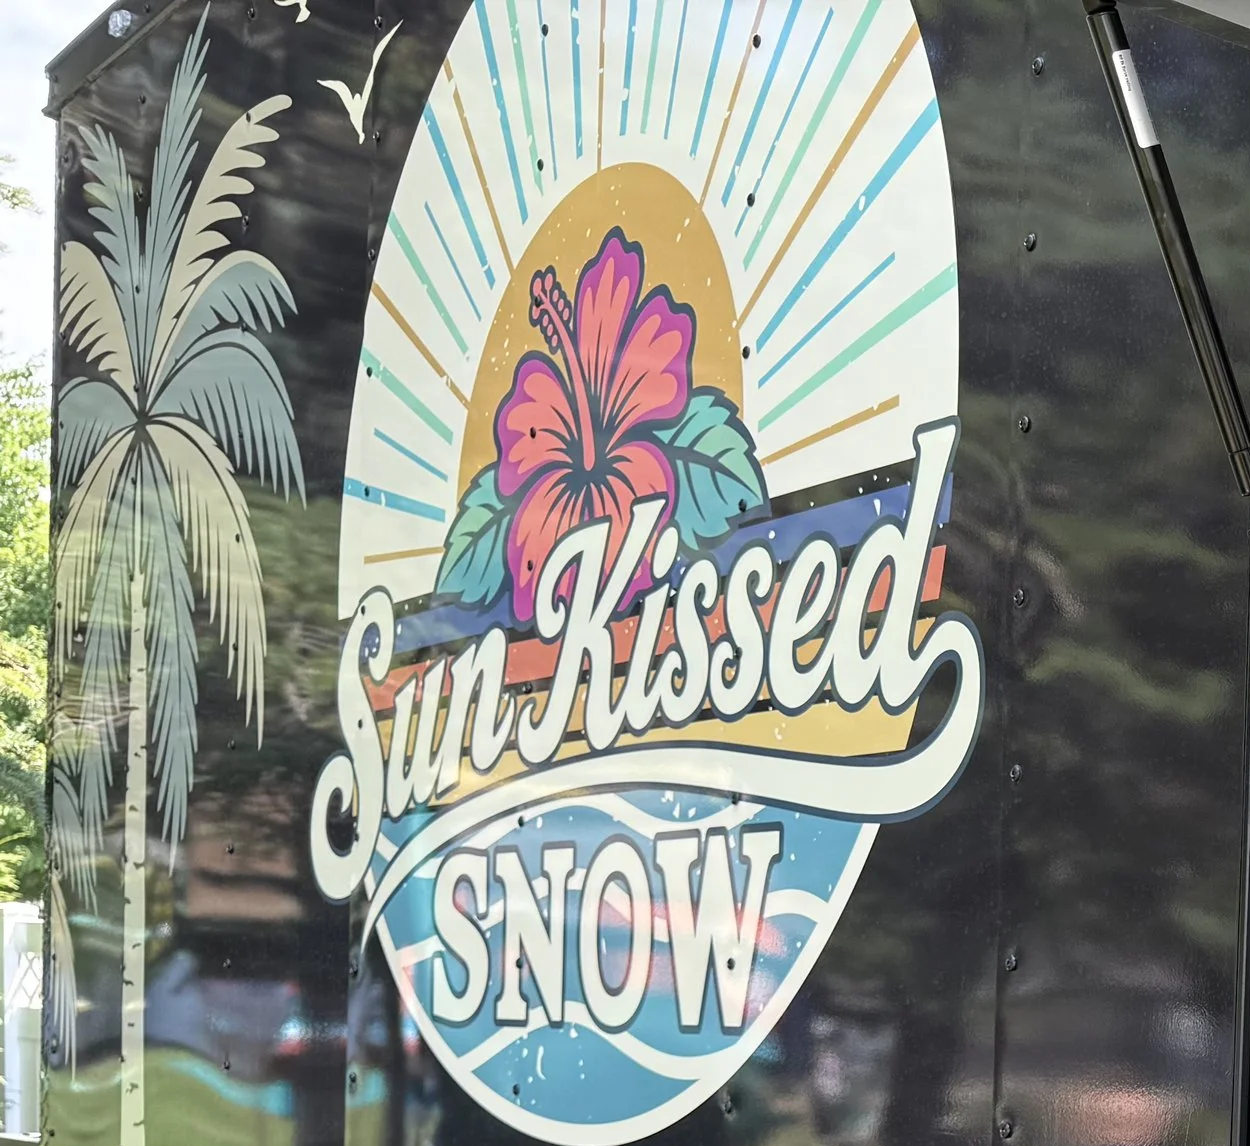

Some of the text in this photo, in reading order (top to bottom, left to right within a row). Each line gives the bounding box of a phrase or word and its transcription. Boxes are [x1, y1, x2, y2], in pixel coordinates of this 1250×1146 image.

[310, 418, 962, 902] Sun Kissed
[431, 823, 784, 1034] SNOW
